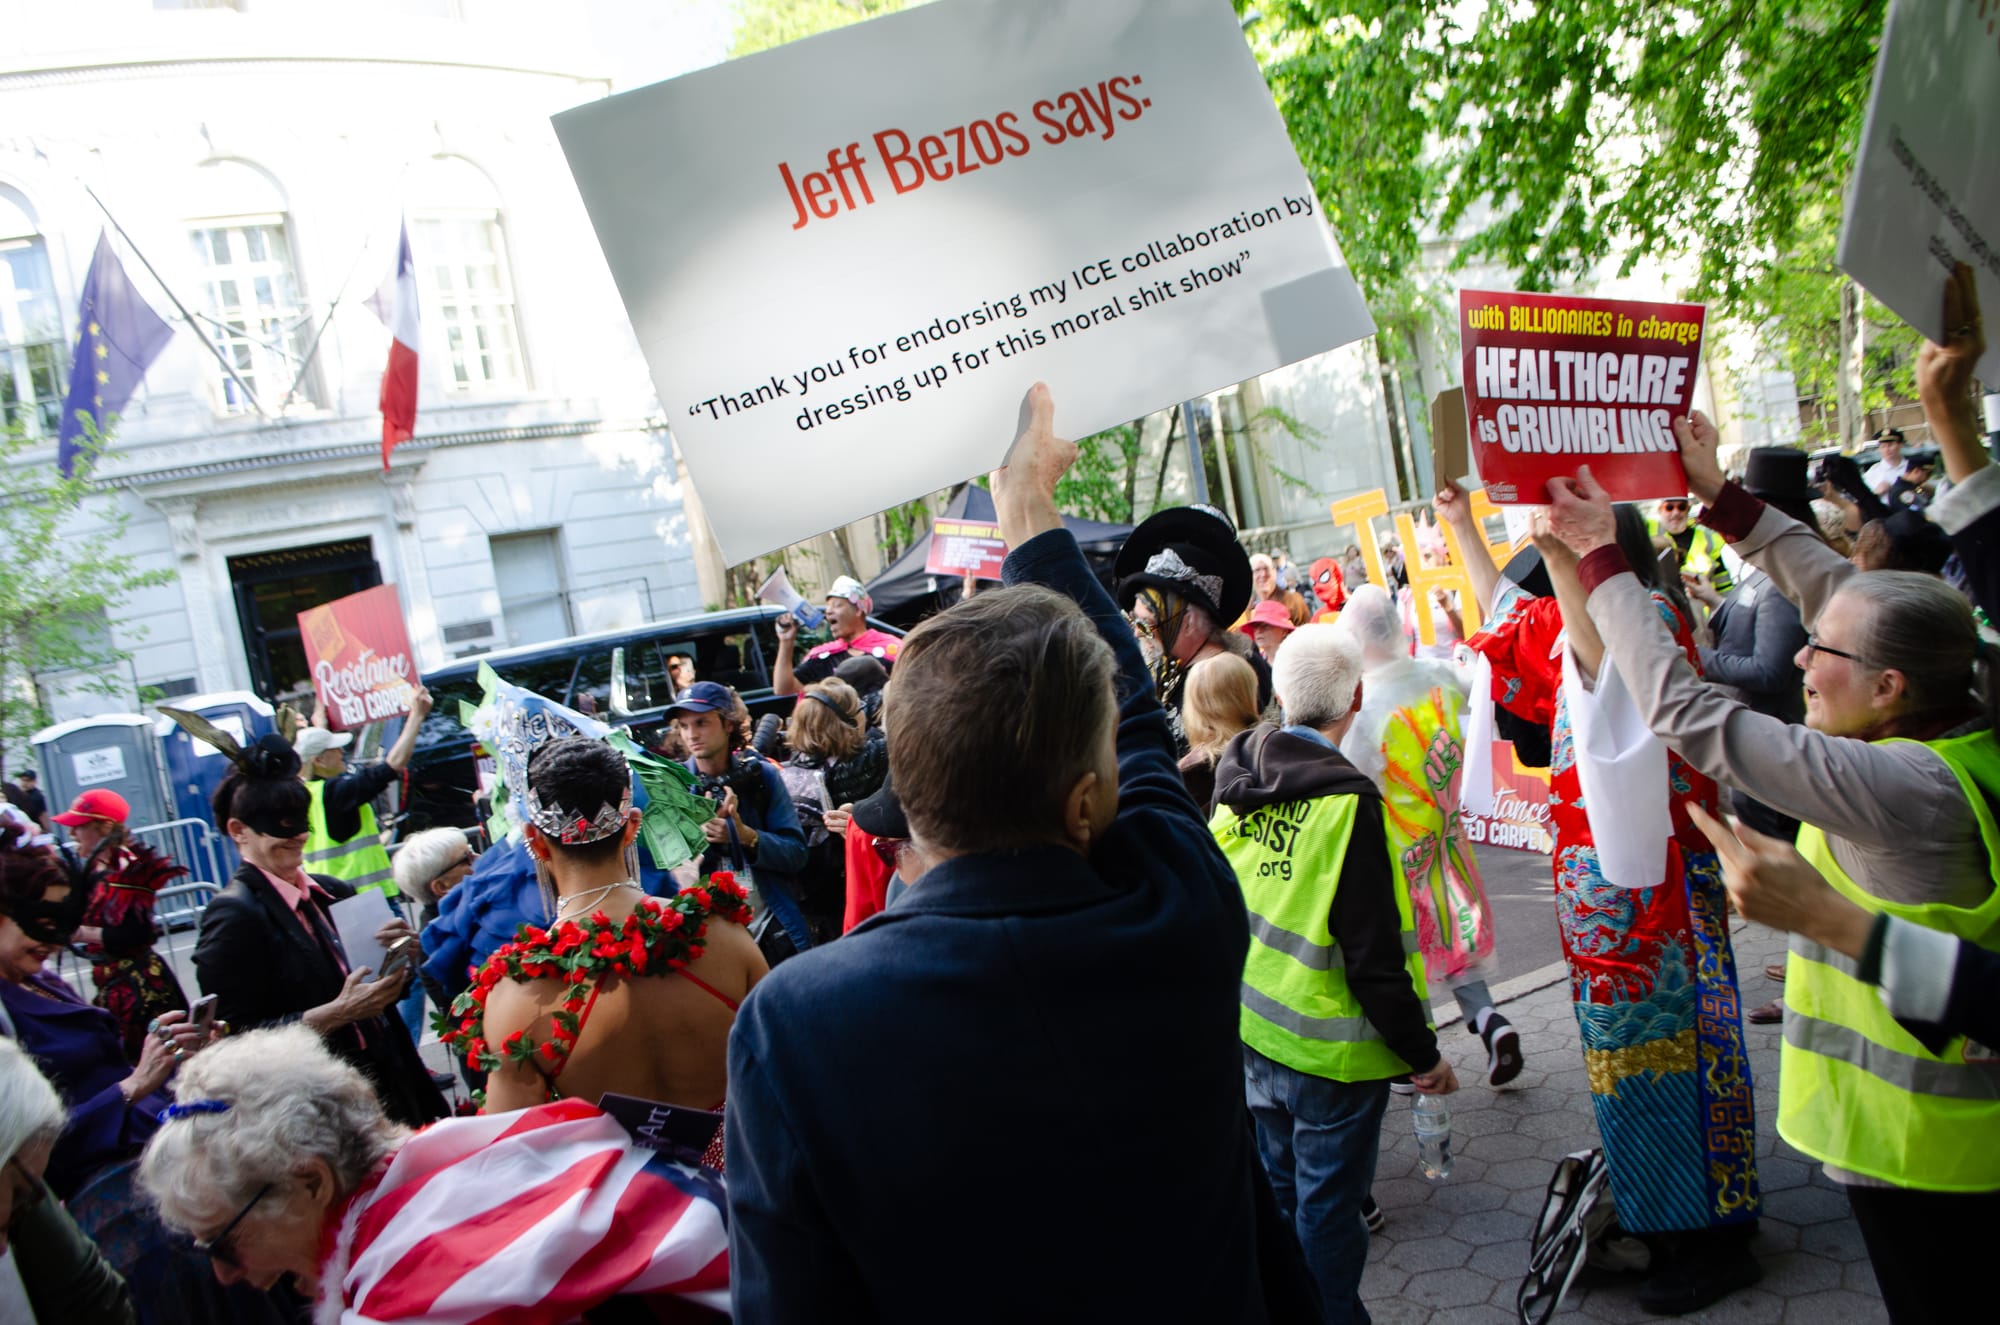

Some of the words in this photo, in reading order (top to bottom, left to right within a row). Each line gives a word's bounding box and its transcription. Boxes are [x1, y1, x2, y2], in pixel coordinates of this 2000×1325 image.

[778, 143, 874, 230] Jeff
[873, 112, 1030, 194] Bezos
[1032, 75, 1152, 140] says:
[793, 360, 844, 396] you
[849, 343, 888, 369] for
[896, 294, 1028, 352] endorsing
[1029, 279, 1067, 306] my
[1072, 259, 1118, 290] ICE
[1121, 207, 1281, 273] collaboration
[1283, 193, 1314, 217] by
[1468, 305, 1505, 331] with
[1509, 306, 1613, 337] BILLIONAIRES
[1616, 313, 1633, 338] in
[1637, 314, 1699, 346] charge
[796, 377, 912, 431] dressing
[913, 365, 948, 388] up
[952, 348, 990, 374] for
[996, 330, 1046, 357] this
[1051, 296, 1126, 339] moral
[1129, 281, 1177, 311] shit
[1475, 345, 1689, 405] HEALTHCARE
[1477, 415, 1498, 443] is
[1496, 404, 1679, 454] CRUMBLING
[315, 647, 411, 707] Resistance
[1226, 811, 1301, 858] ESIST
[1464, 819, 1486, 842] ED
[1489, 821, 1547, 852] CARPET
[1256, 860, 1293, 882] .org
[636, 1106, 672, 1139] Art
